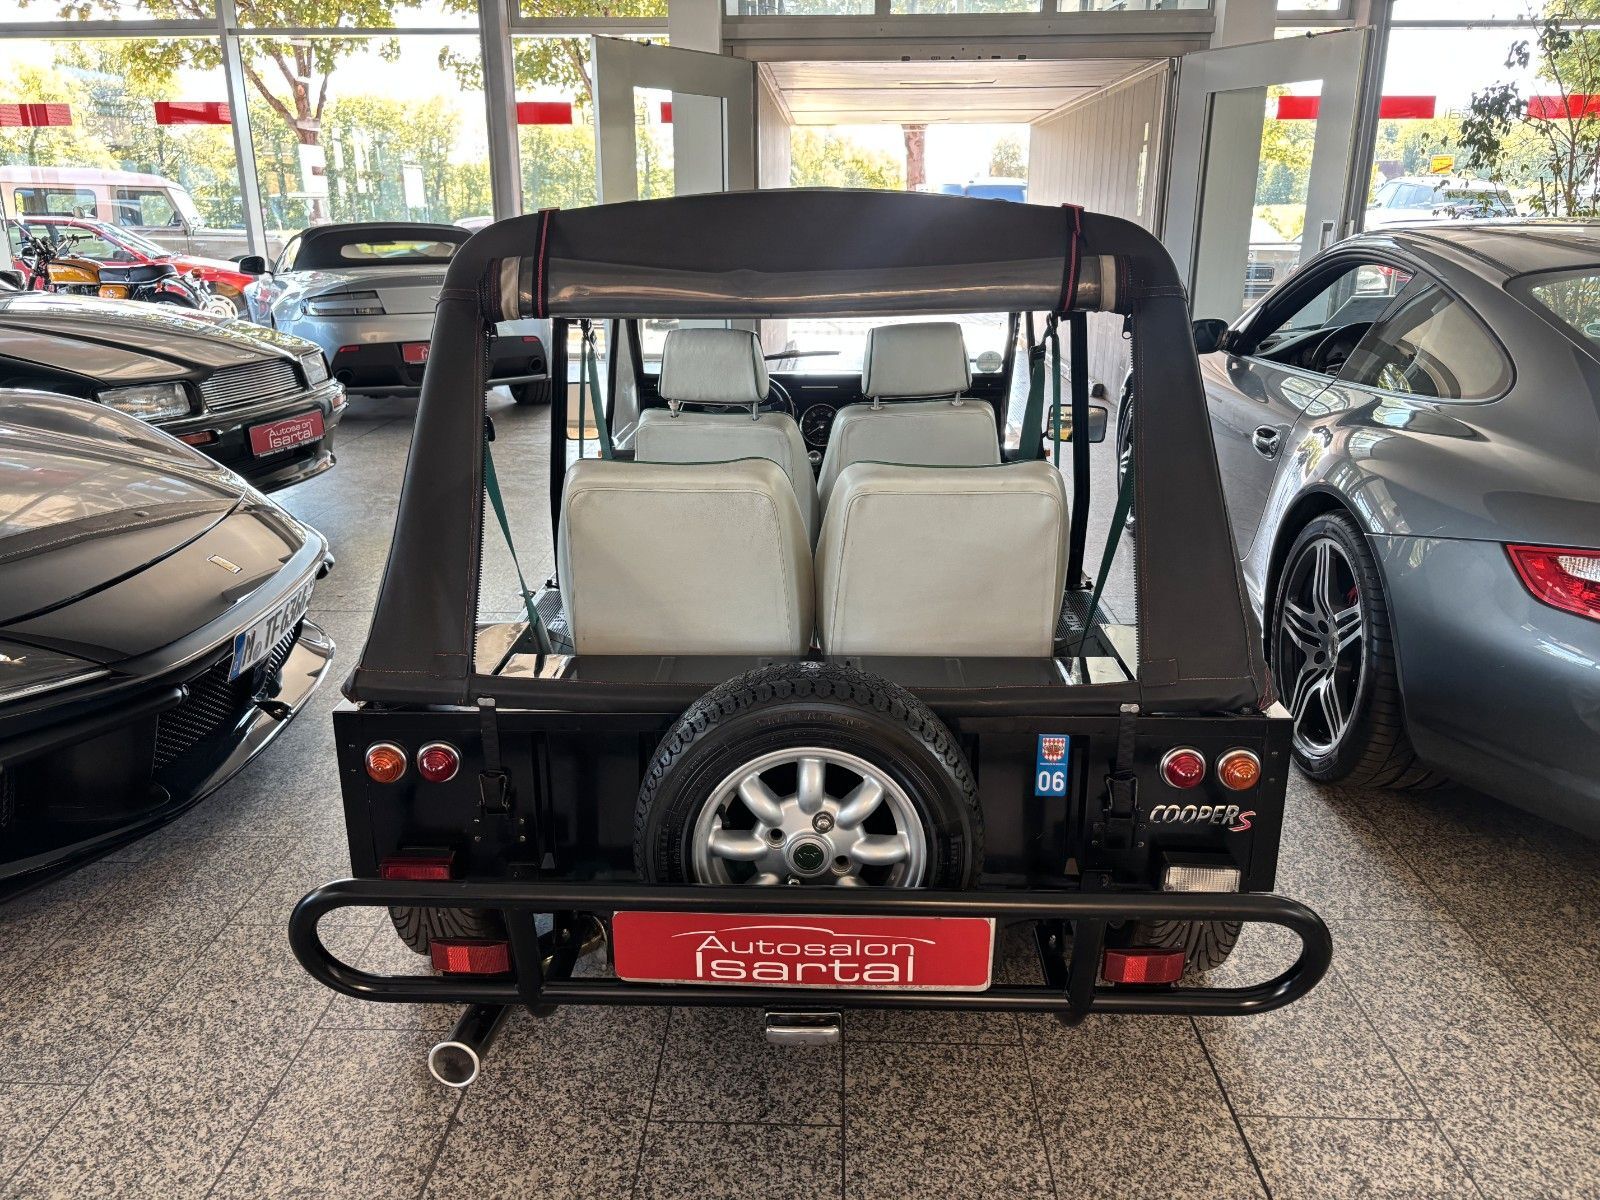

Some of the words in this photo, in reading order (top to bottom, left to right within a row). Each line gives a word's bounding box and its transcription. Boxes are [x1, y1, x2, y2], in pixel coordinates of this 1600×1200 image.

[269, 421, 312, 438] Autosaon
[269, 426, 314, 449] Isartal
[241, 628, 257, 668] M
[264, 608, 283, 649] TF
[1038, 770, 1065, 792] 06
[1149, 804, 1240, 826] COOPER
[1228, 810, 1257, 832] S
[696, 935, 915, 957] Autosalon
[695, 951, 915, 982] Isartal
